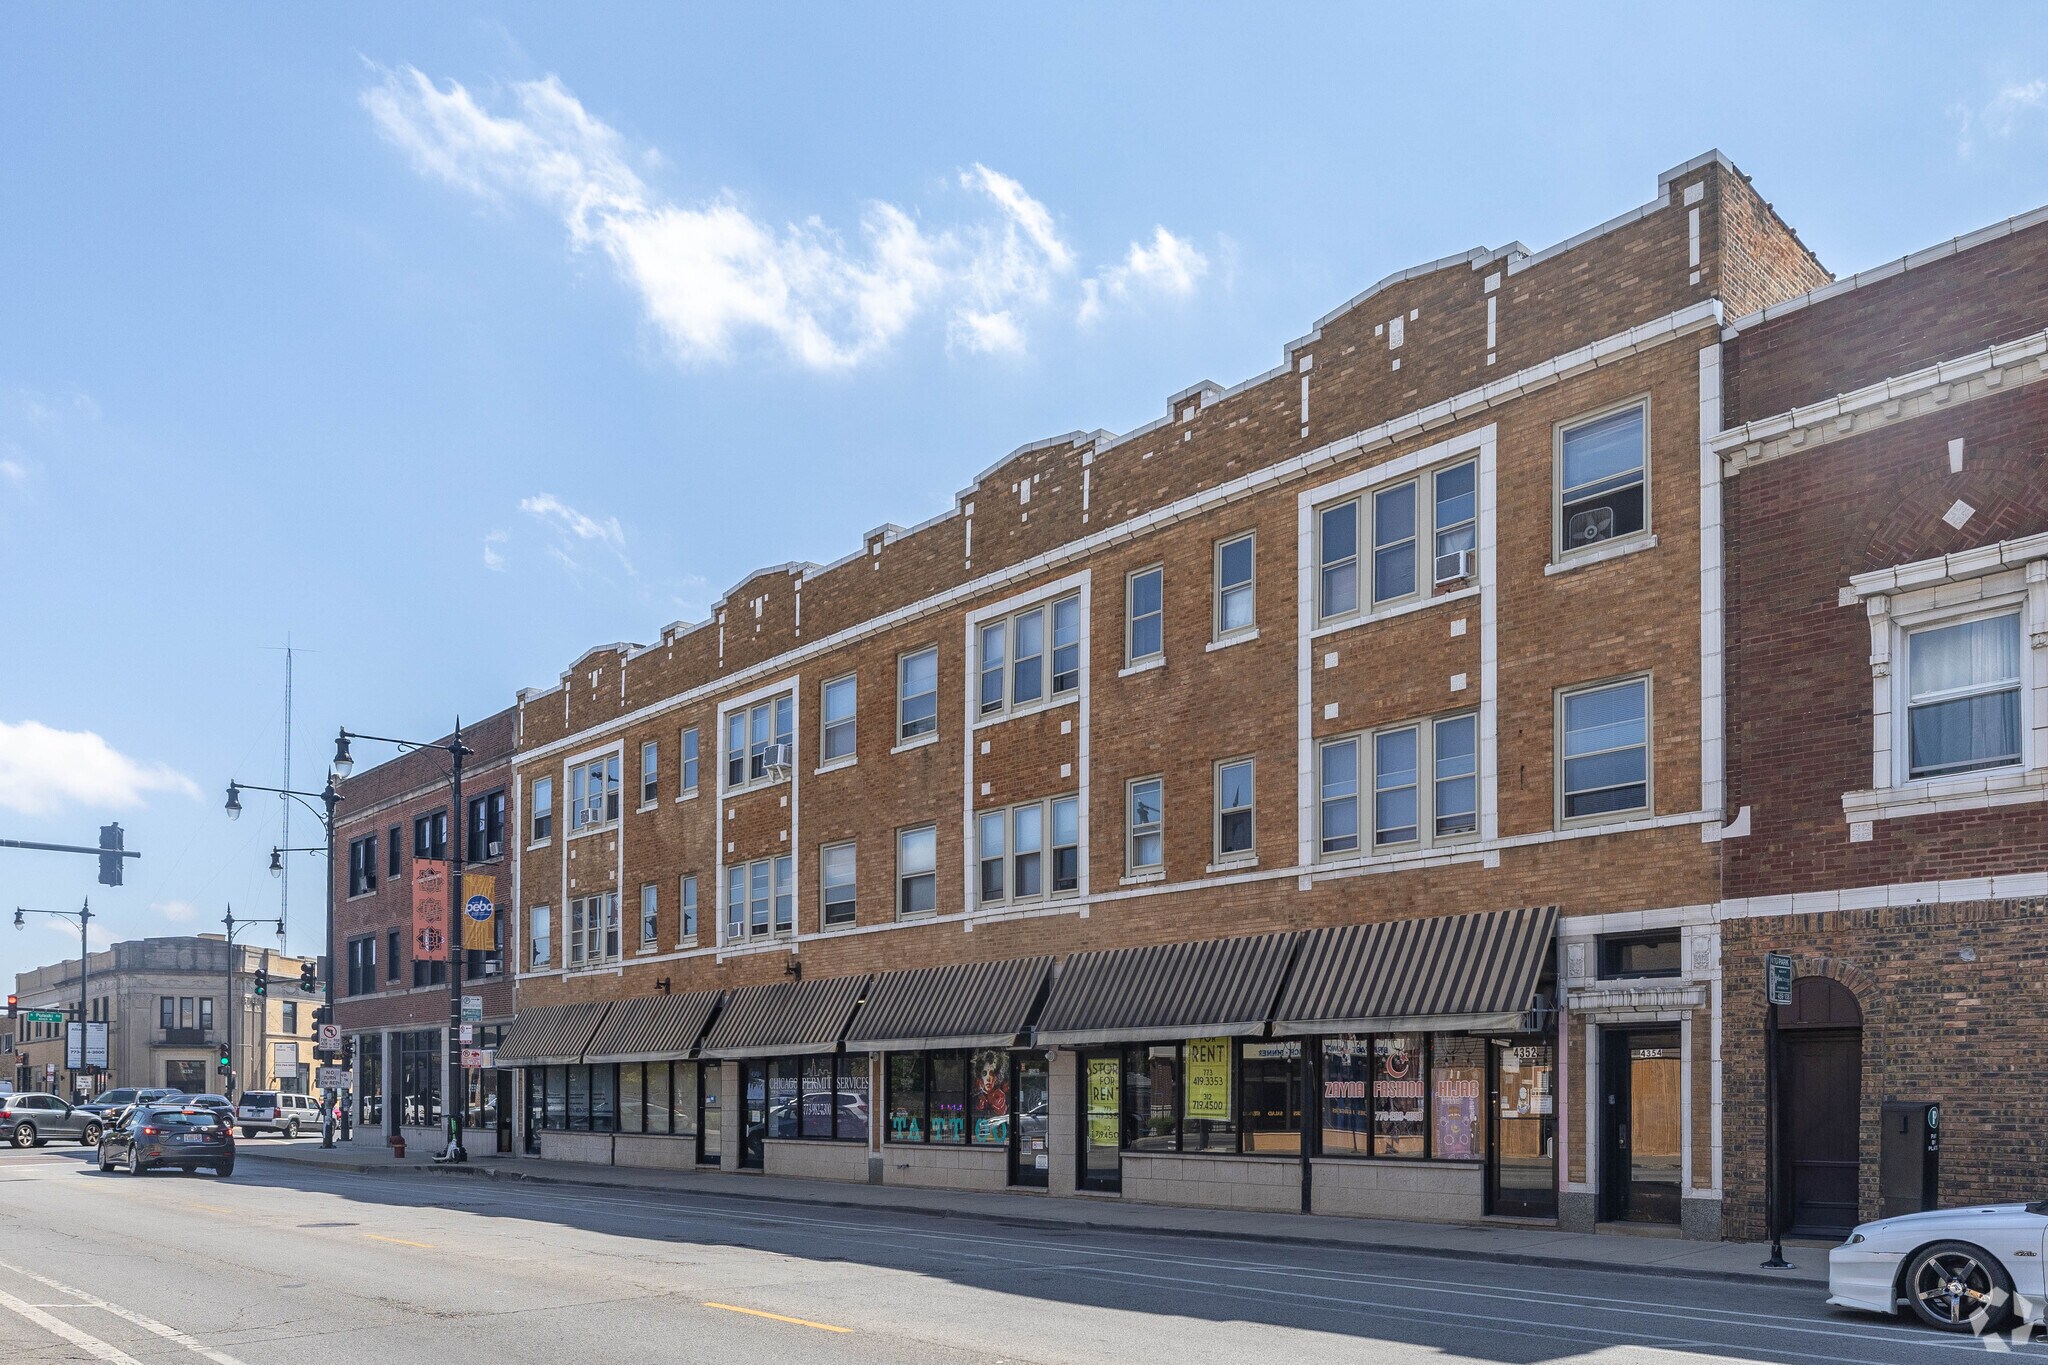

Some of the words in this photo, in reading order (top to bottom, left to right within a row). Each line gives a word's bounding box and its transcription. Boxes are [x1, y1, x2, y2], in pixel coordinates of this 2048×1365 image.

[1192, 1045, 1225, 1062] RENT
[1513, 1046, 1537, 1058] 4352
[1640, 1049, 1662, 1058] 4354
[1091, 1062, 1119, 1075] STOR
[769, 1077, 798, 1090] CHICAGO
[801, 1076, 833, 1090] PERMIT
[836, 1076, 869, 1090] SERVICES
[1100, 1076, 1115, 1085] FOR
[1193, 1077, 1224, 1086] 419.3353
[1325, 1081, 1364, 1098] ZAYNA
[1373, 1081, 1424, 1098] FASHION
[1438, 1080, 1479, 1097] HIJAB
[1193, 1101, 1223, 1110] 719.4500
[893, 1115, 1007, 1143] TATTOO
